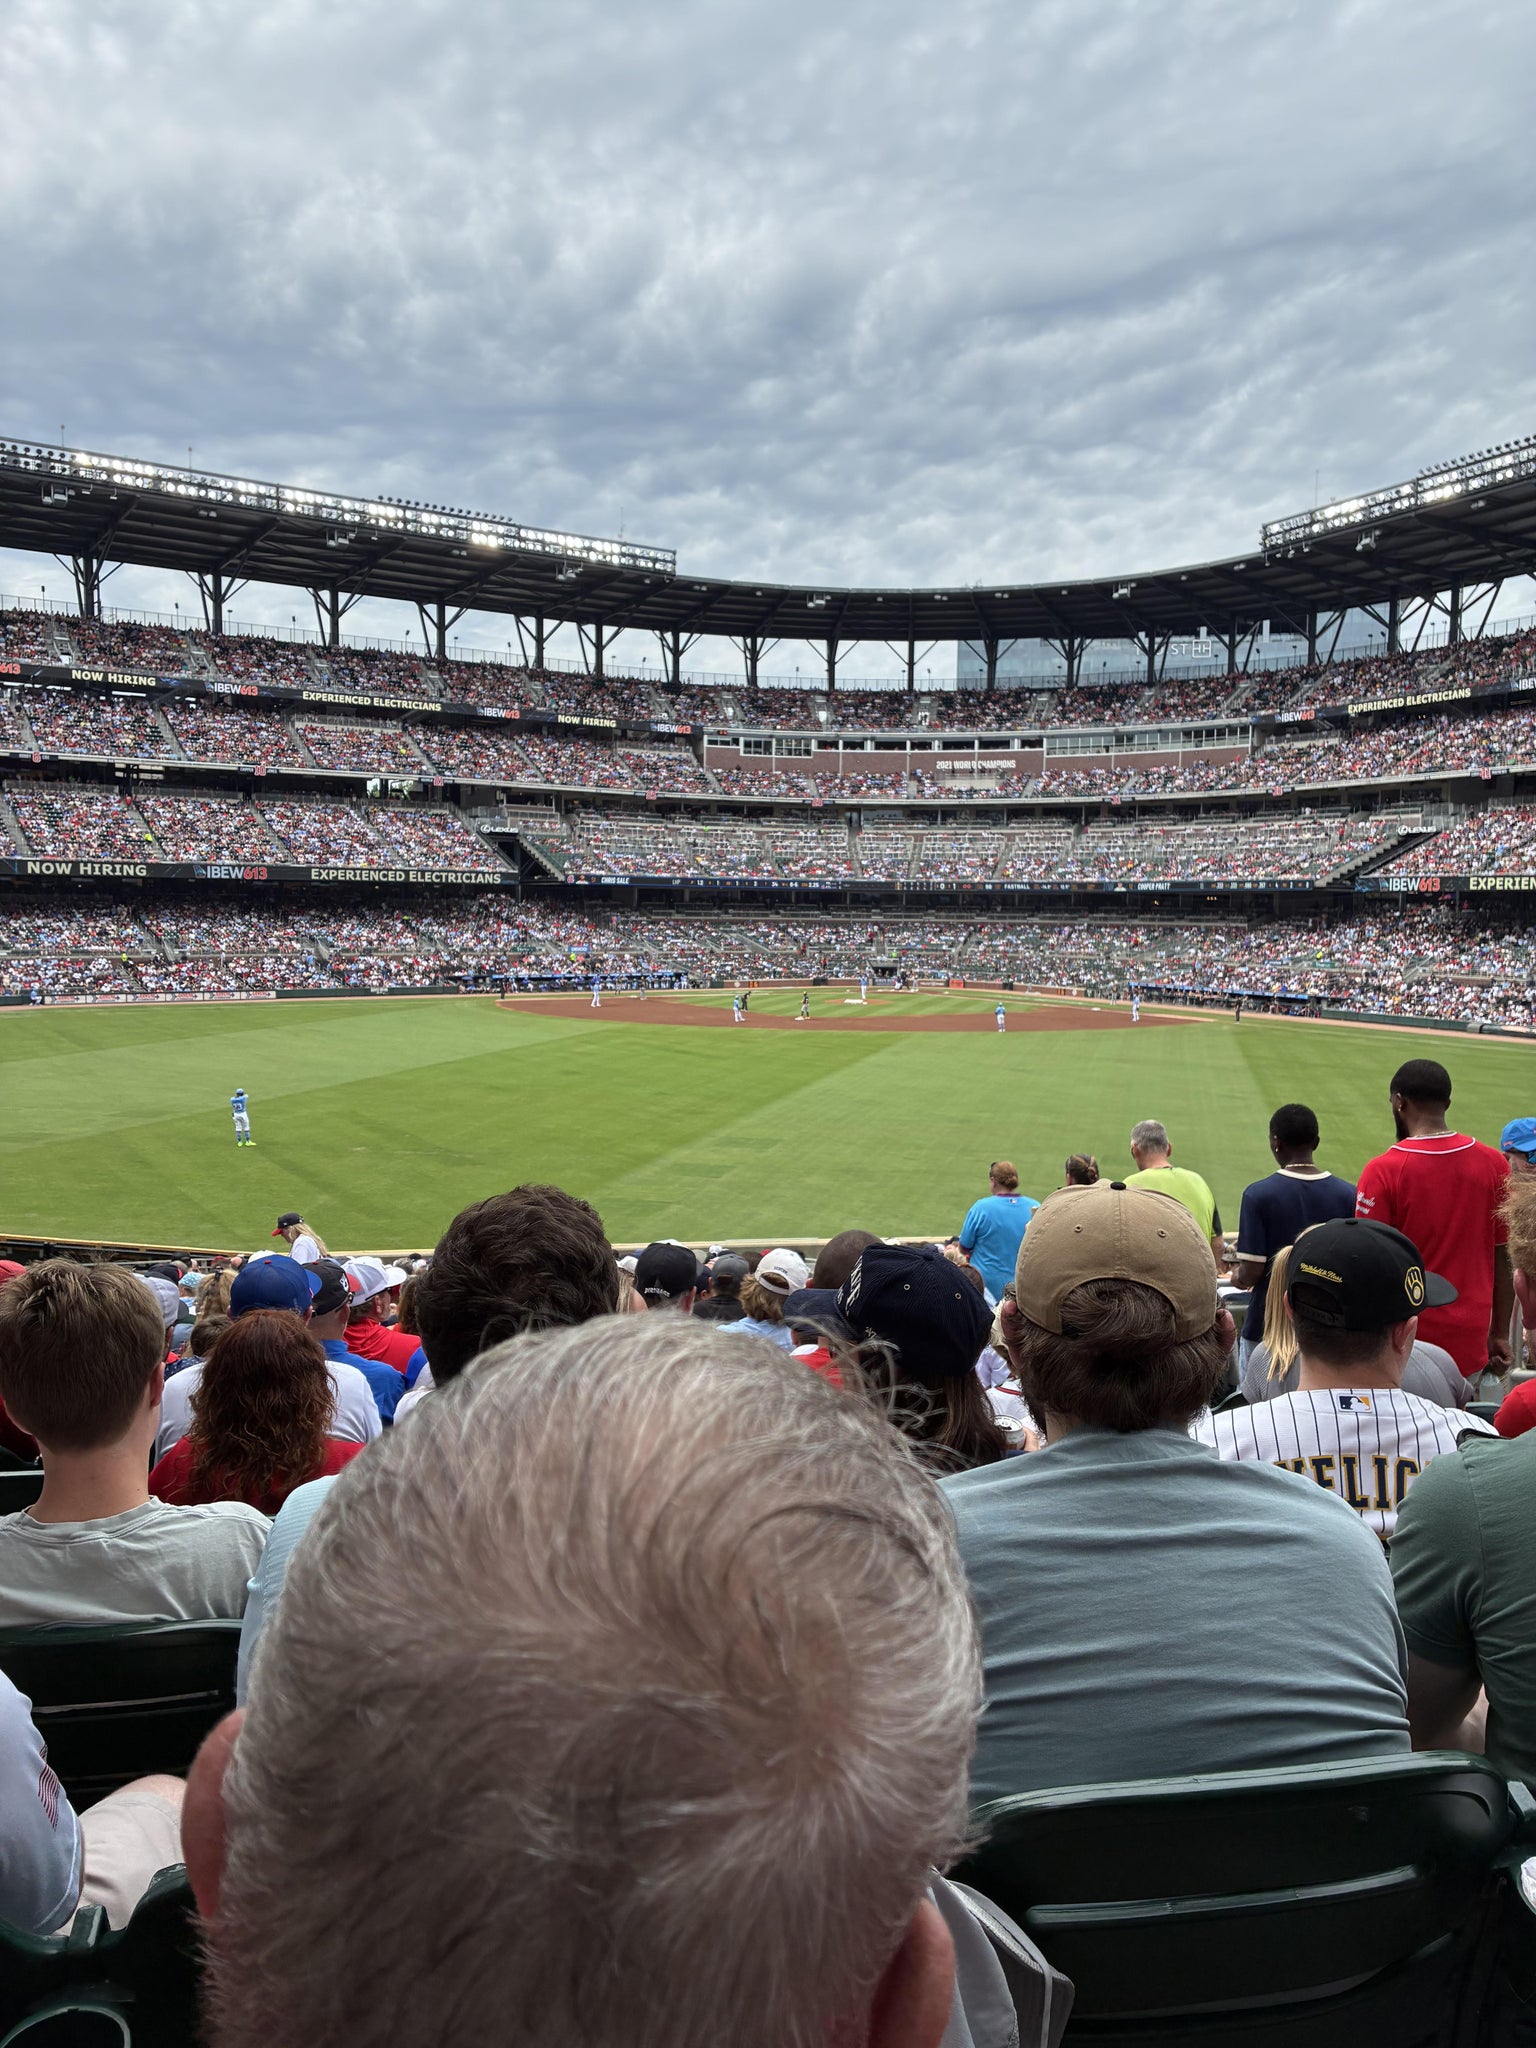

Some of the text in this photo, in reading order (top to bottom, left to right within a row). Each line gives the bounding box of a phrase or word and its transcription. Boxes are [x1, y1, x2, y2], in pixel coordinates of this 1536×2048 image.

[72, 670, 156, 686] NOW HIRING
[1519, 677, 1536, 690] IBE
[302, 691, 442, 711] EXPERIENCED ELECTRICIANS
[1348, 688, 1471, 714] EXPERIENCED ELECTRICIANS
[558, 715, 617, 728] NOW HIRING
[936, 761, 952, 769] 2021
[978, 760, 1016, 769] CHAMPIONS
[27, 861, 147, 876] NOW HIRING
[311, 868, 501, 884] EXPERIENCED ELECTRICIANS
